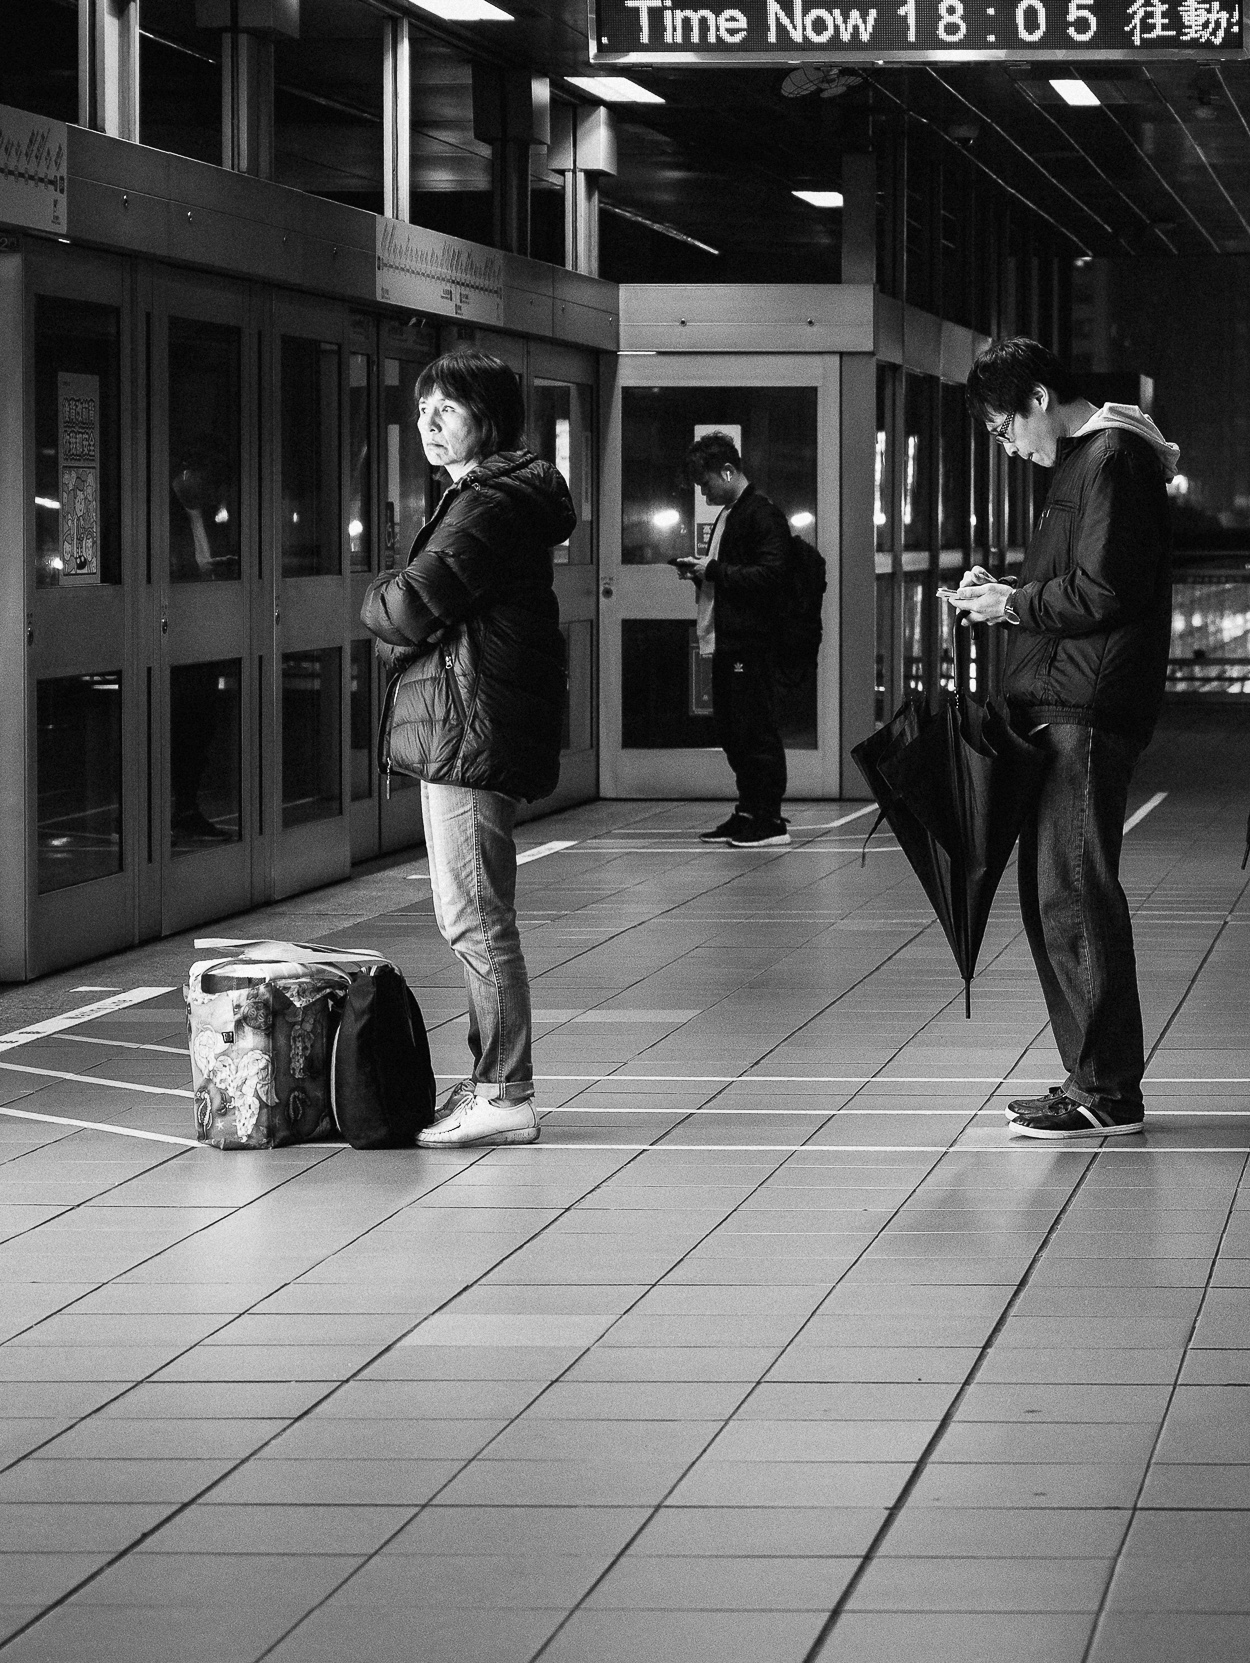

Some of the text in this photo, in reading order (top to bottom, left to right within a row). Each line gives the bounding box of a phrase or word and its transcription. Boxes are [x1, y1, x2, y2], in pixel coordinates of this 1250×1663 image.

[625, 0, 748, 43] Time
[767, 0, 877, 43] Now
[1124, 0, 1240, 46] 往動
